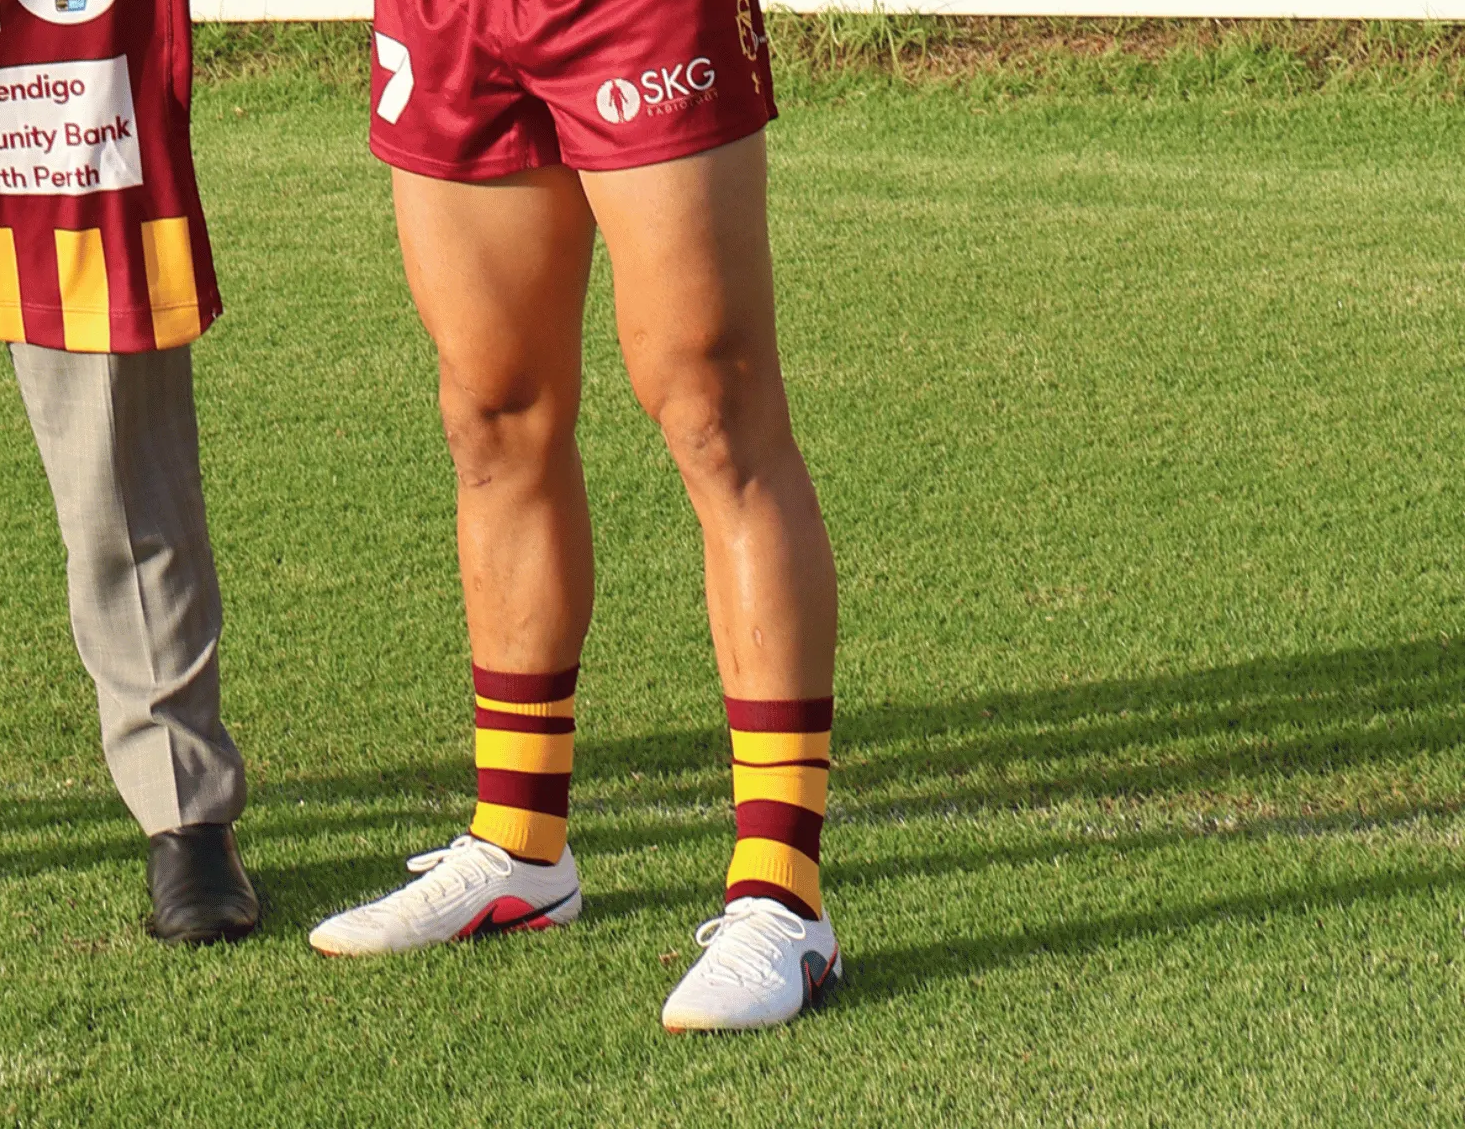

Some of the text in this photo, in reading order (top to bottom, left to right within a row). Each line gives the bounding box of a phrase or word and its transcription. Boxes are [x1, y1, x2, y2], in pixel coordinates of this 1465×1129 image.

[640, 57, 715, 104] SKG
[65, 116, 132, 147] Bank
[34, 165, 101, 188] Perth
